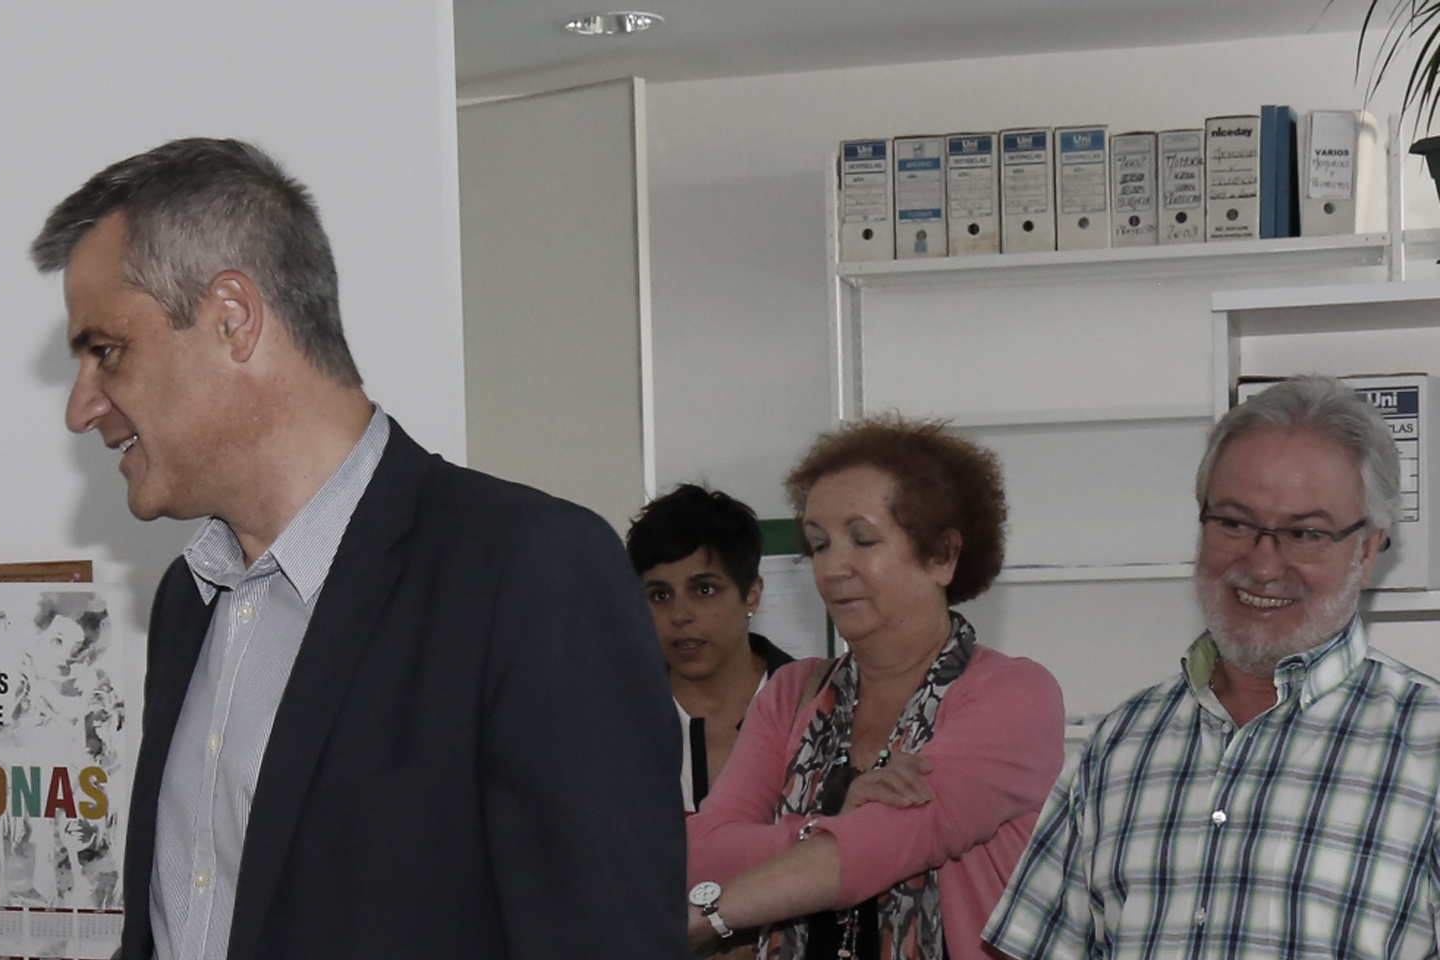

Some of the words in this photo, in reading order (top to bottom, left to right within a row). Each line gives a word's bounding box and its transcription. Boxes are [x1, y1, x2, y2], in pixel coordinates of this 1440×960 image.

[1211, 127, 1253, 138] niceday
[1073, 134, 1092, 145] Uni
[1314, 149, 1350, 157] VARIOS
